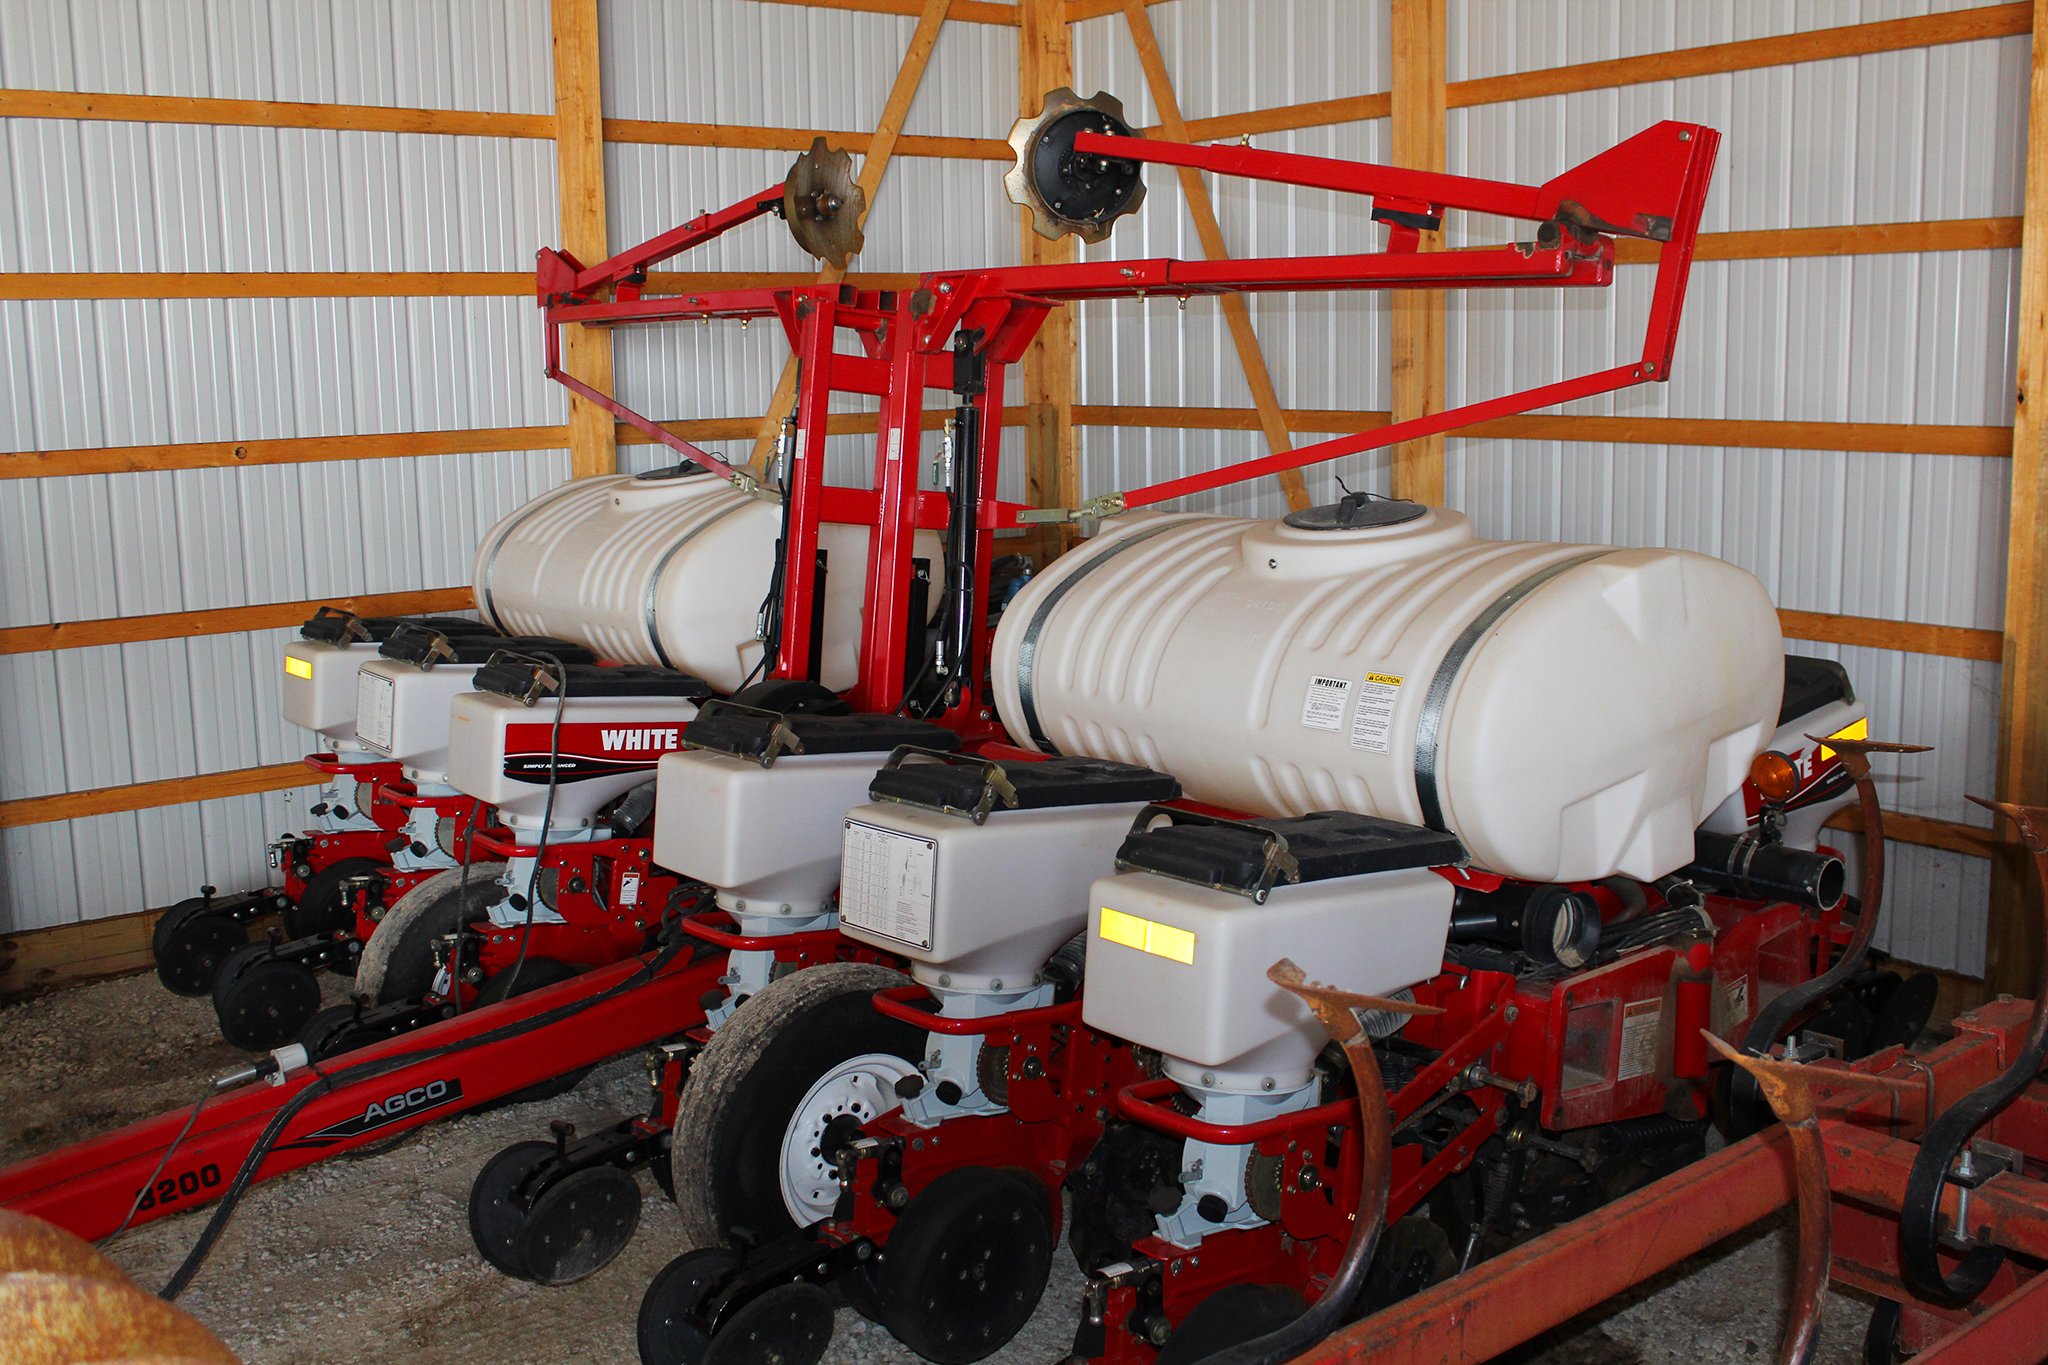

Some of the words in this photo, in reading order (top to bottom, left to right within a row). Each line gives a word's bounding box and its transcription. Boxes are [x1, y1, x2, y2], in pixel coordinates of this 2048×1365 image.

[1315, 678, 1347, 689] IMPORTANT
[1375, 675, 1401, 684] CAUTION
[600, 728, 678, 751] WHITE
[363, 1080, 447, 1123] AGCO
[135, 1163, 221, 1211] 8200
